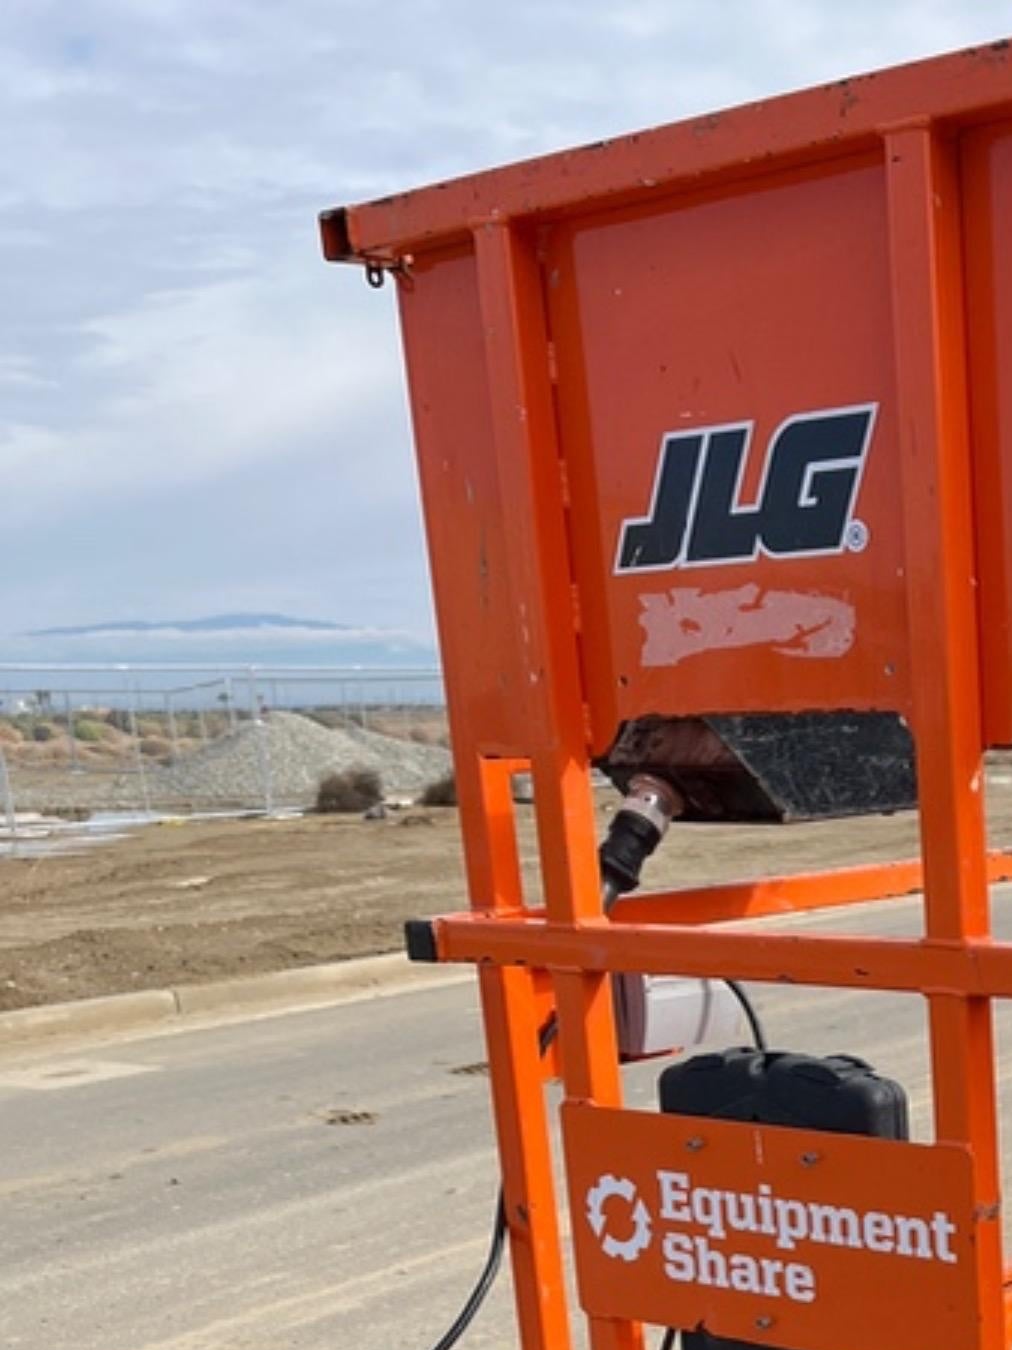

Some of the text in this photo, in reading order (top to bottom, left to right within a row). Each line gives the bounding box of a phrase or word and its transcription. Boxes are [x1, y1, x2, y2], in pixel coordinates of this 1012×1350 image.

[613, 402, 880, 575] JLG
[656, 1170, 959, 1264] Equipment
[662, 1232, 815, 1303] Share
